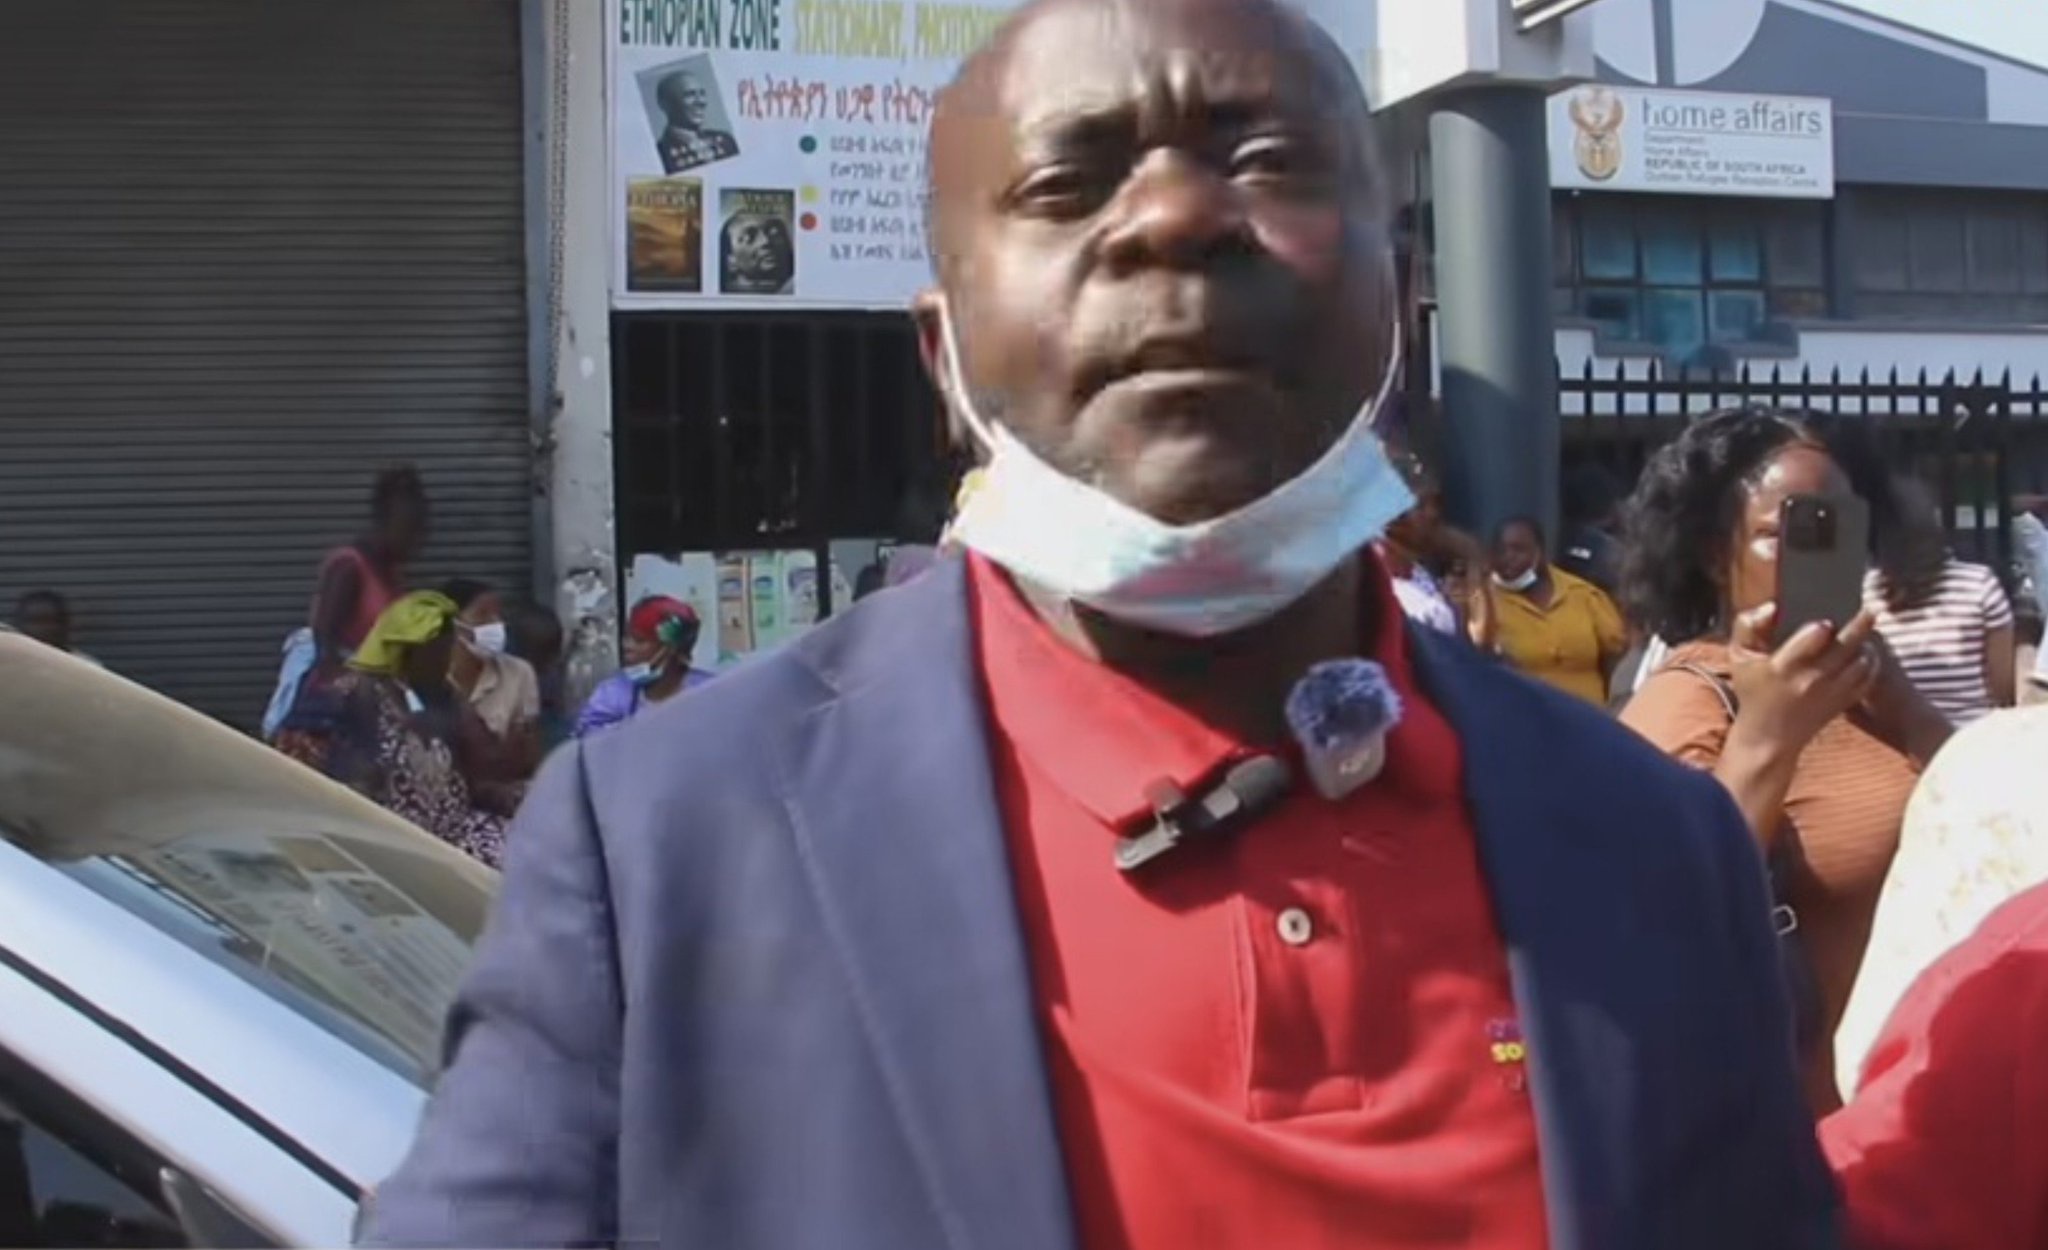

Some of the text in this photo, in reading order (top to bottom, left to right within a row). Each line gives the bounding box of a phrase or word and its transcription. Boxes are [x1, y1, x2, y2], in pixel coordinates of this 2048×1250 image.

[619, 0, 720, 48] ETHIOPIAN
[730, 0, 780, 50] ZONE
[1643, 97, 1822, 134] home affairs
[1645, 158, 1806, 175] REPUBLIC OF SOUTH AFRICA
